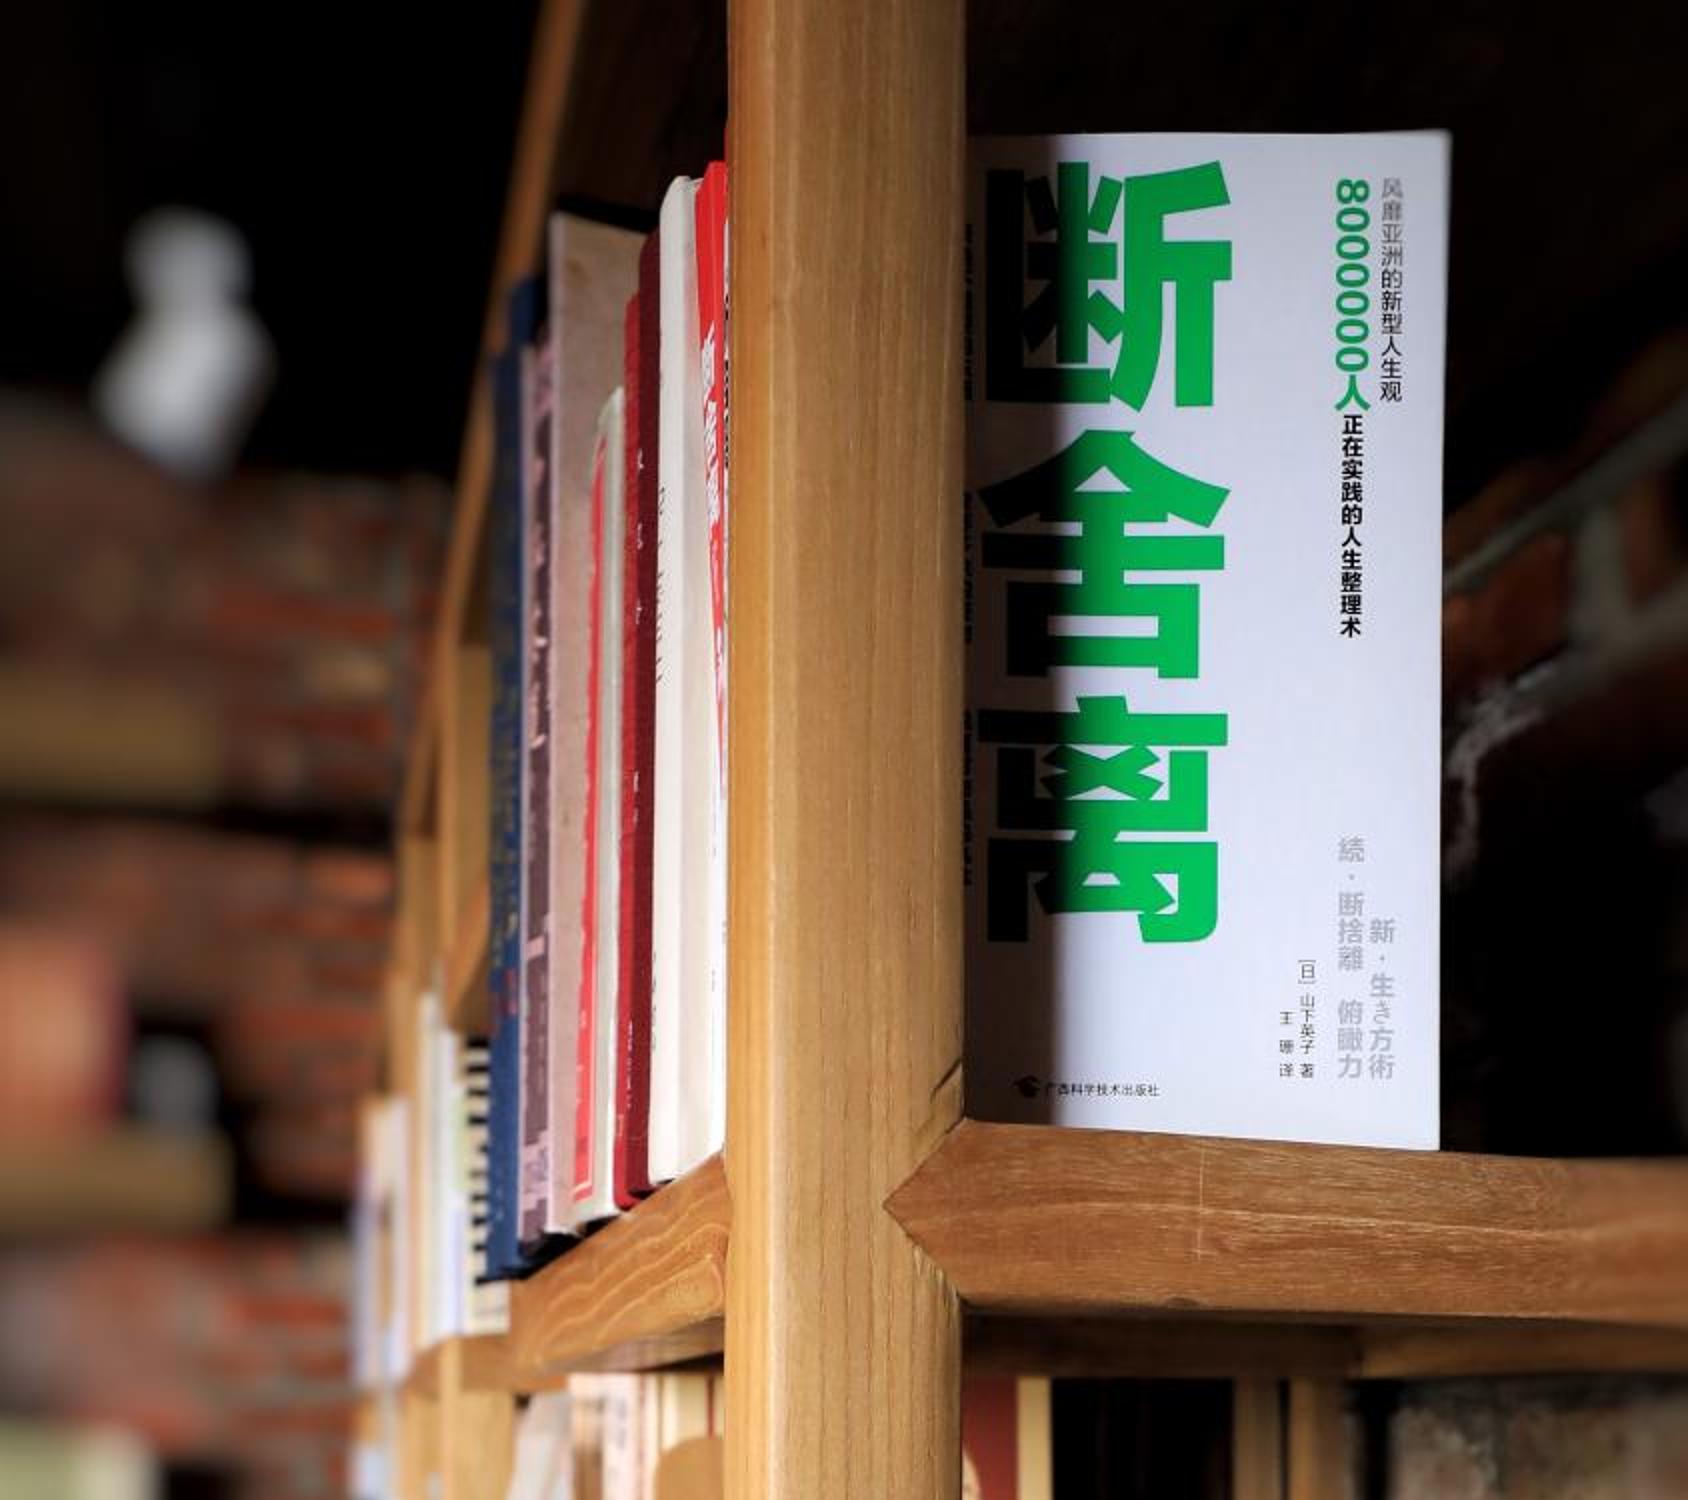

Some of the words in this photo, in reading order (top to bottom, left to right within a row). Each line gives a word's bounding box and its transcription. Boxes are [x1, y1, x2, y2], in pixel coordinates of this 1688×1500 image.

[1380, 177, 1403, 402] 风靡亚洲的新型人生观
[976, 160, 1233, 944] 断舍离
